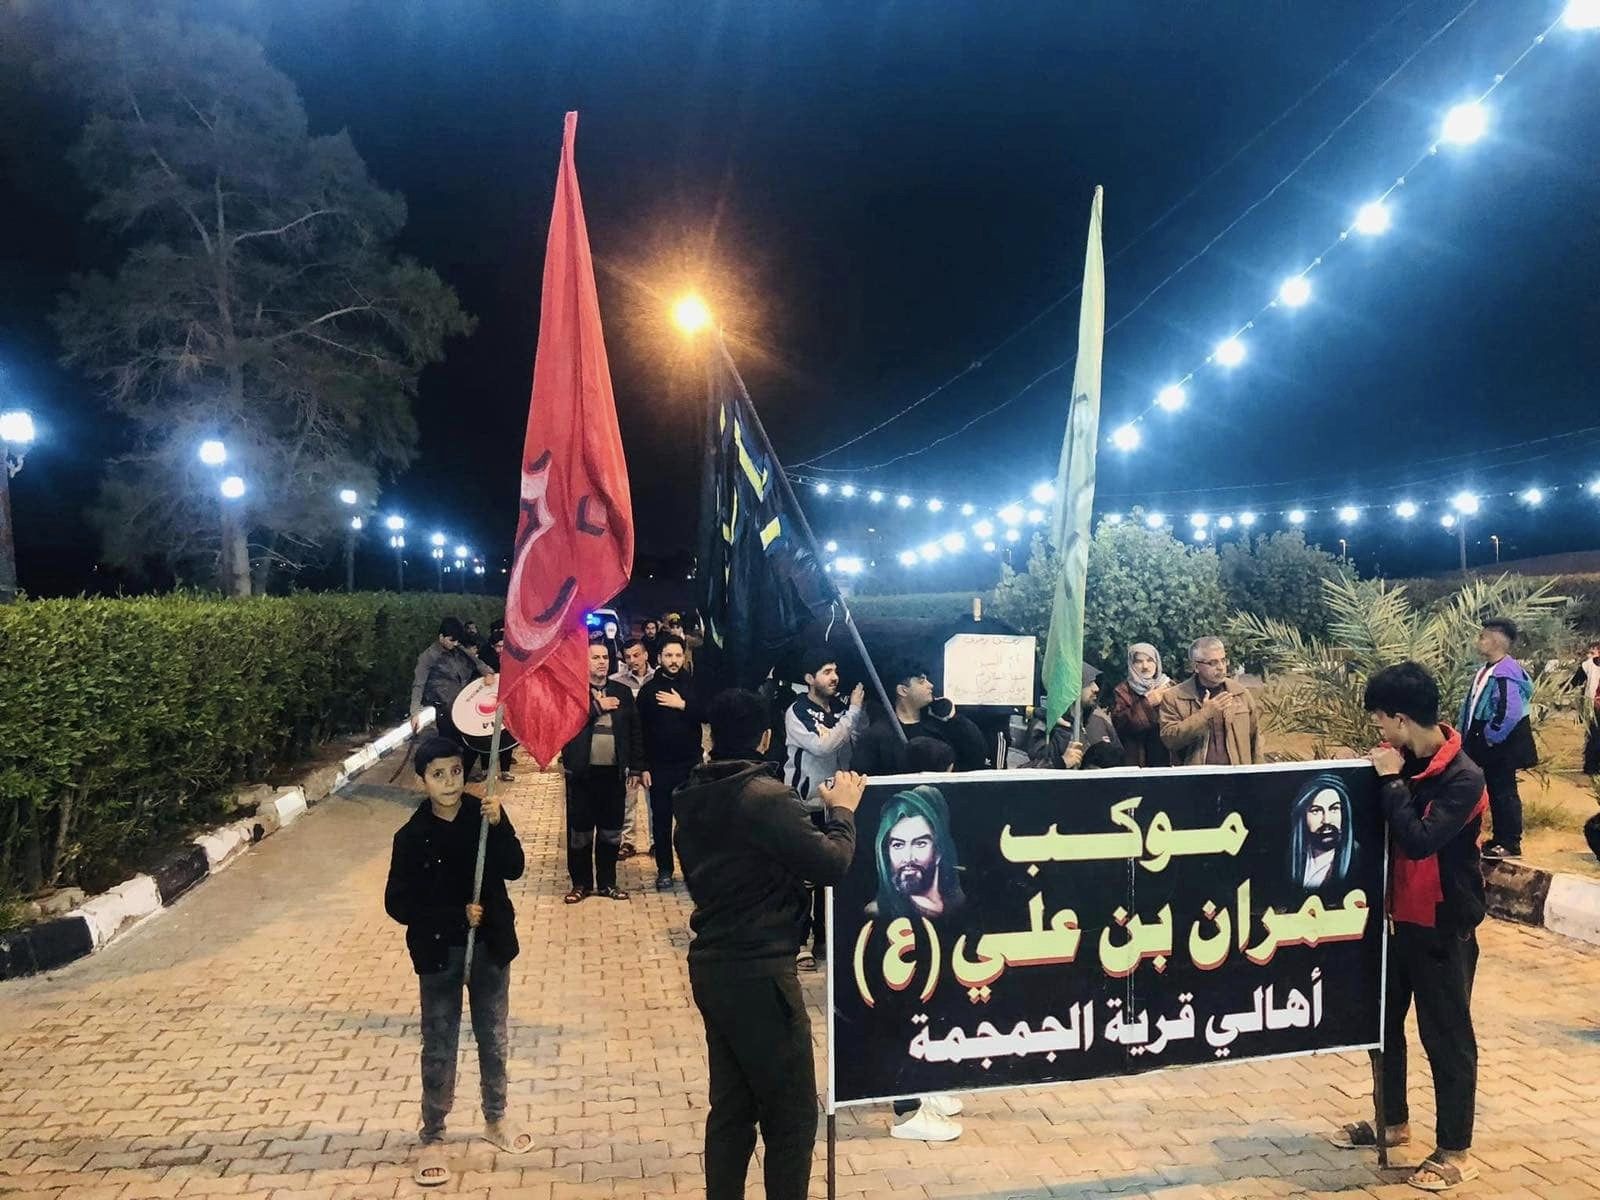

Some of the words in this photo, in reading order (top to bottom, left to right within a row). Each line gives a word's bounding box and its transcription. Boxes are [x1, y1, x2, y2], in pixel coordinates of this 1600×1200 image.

[1000, 796, 1249, 877] موكب
[854, 916, 940, 1008] (ع)
[952, 892, 1081, 1004] علي
[1099, 904, 1172, 977] بن
[1189, 879, 1369, 970] عمران
[909, 1000, 1095, 1069] الجمجمة
[1105, 992, 1195, 1056] قرية
[1205, 967, 1323, 1057] أهالي
